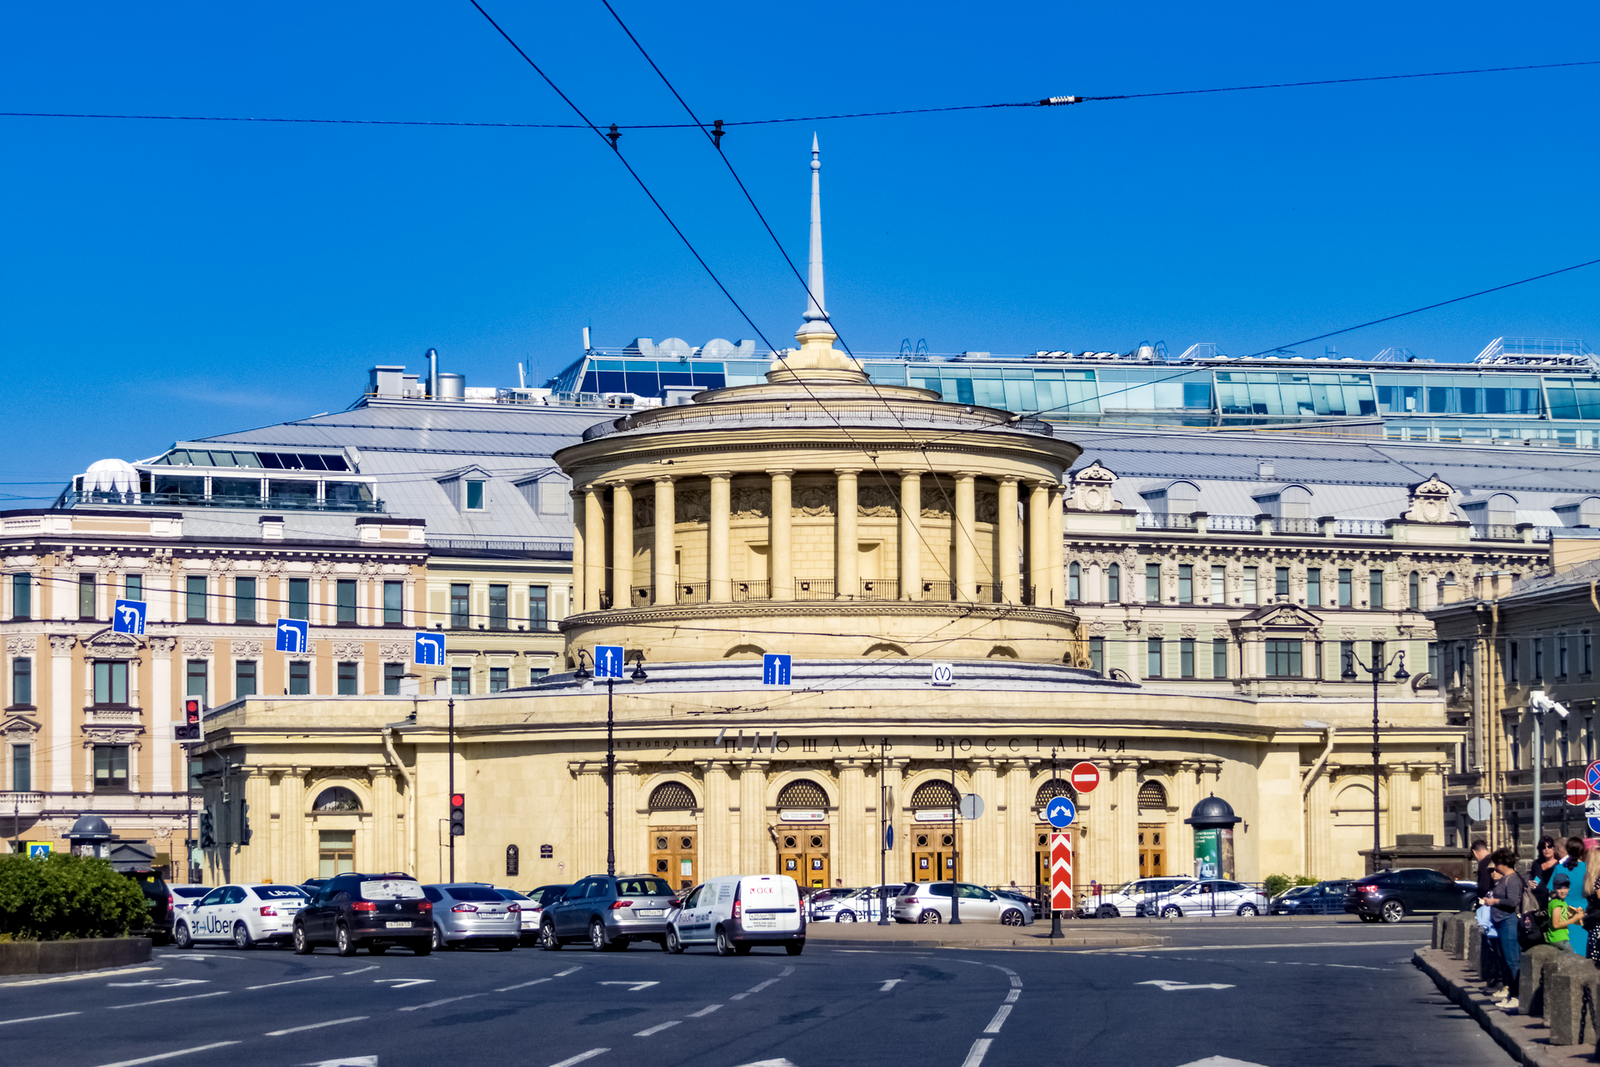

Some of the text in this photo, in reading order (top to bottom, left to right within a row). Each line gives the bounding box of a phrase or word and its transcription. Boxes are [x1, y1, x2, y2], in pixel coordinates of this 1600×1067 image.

[609, 740, 718, 748] ЕТРОПОЛИТЕ
[935, 738, 1126, 754] ВОССТАНИЯ
[267, 889, 301, 897] Uber
[206, 915, 233, 934] Uber
